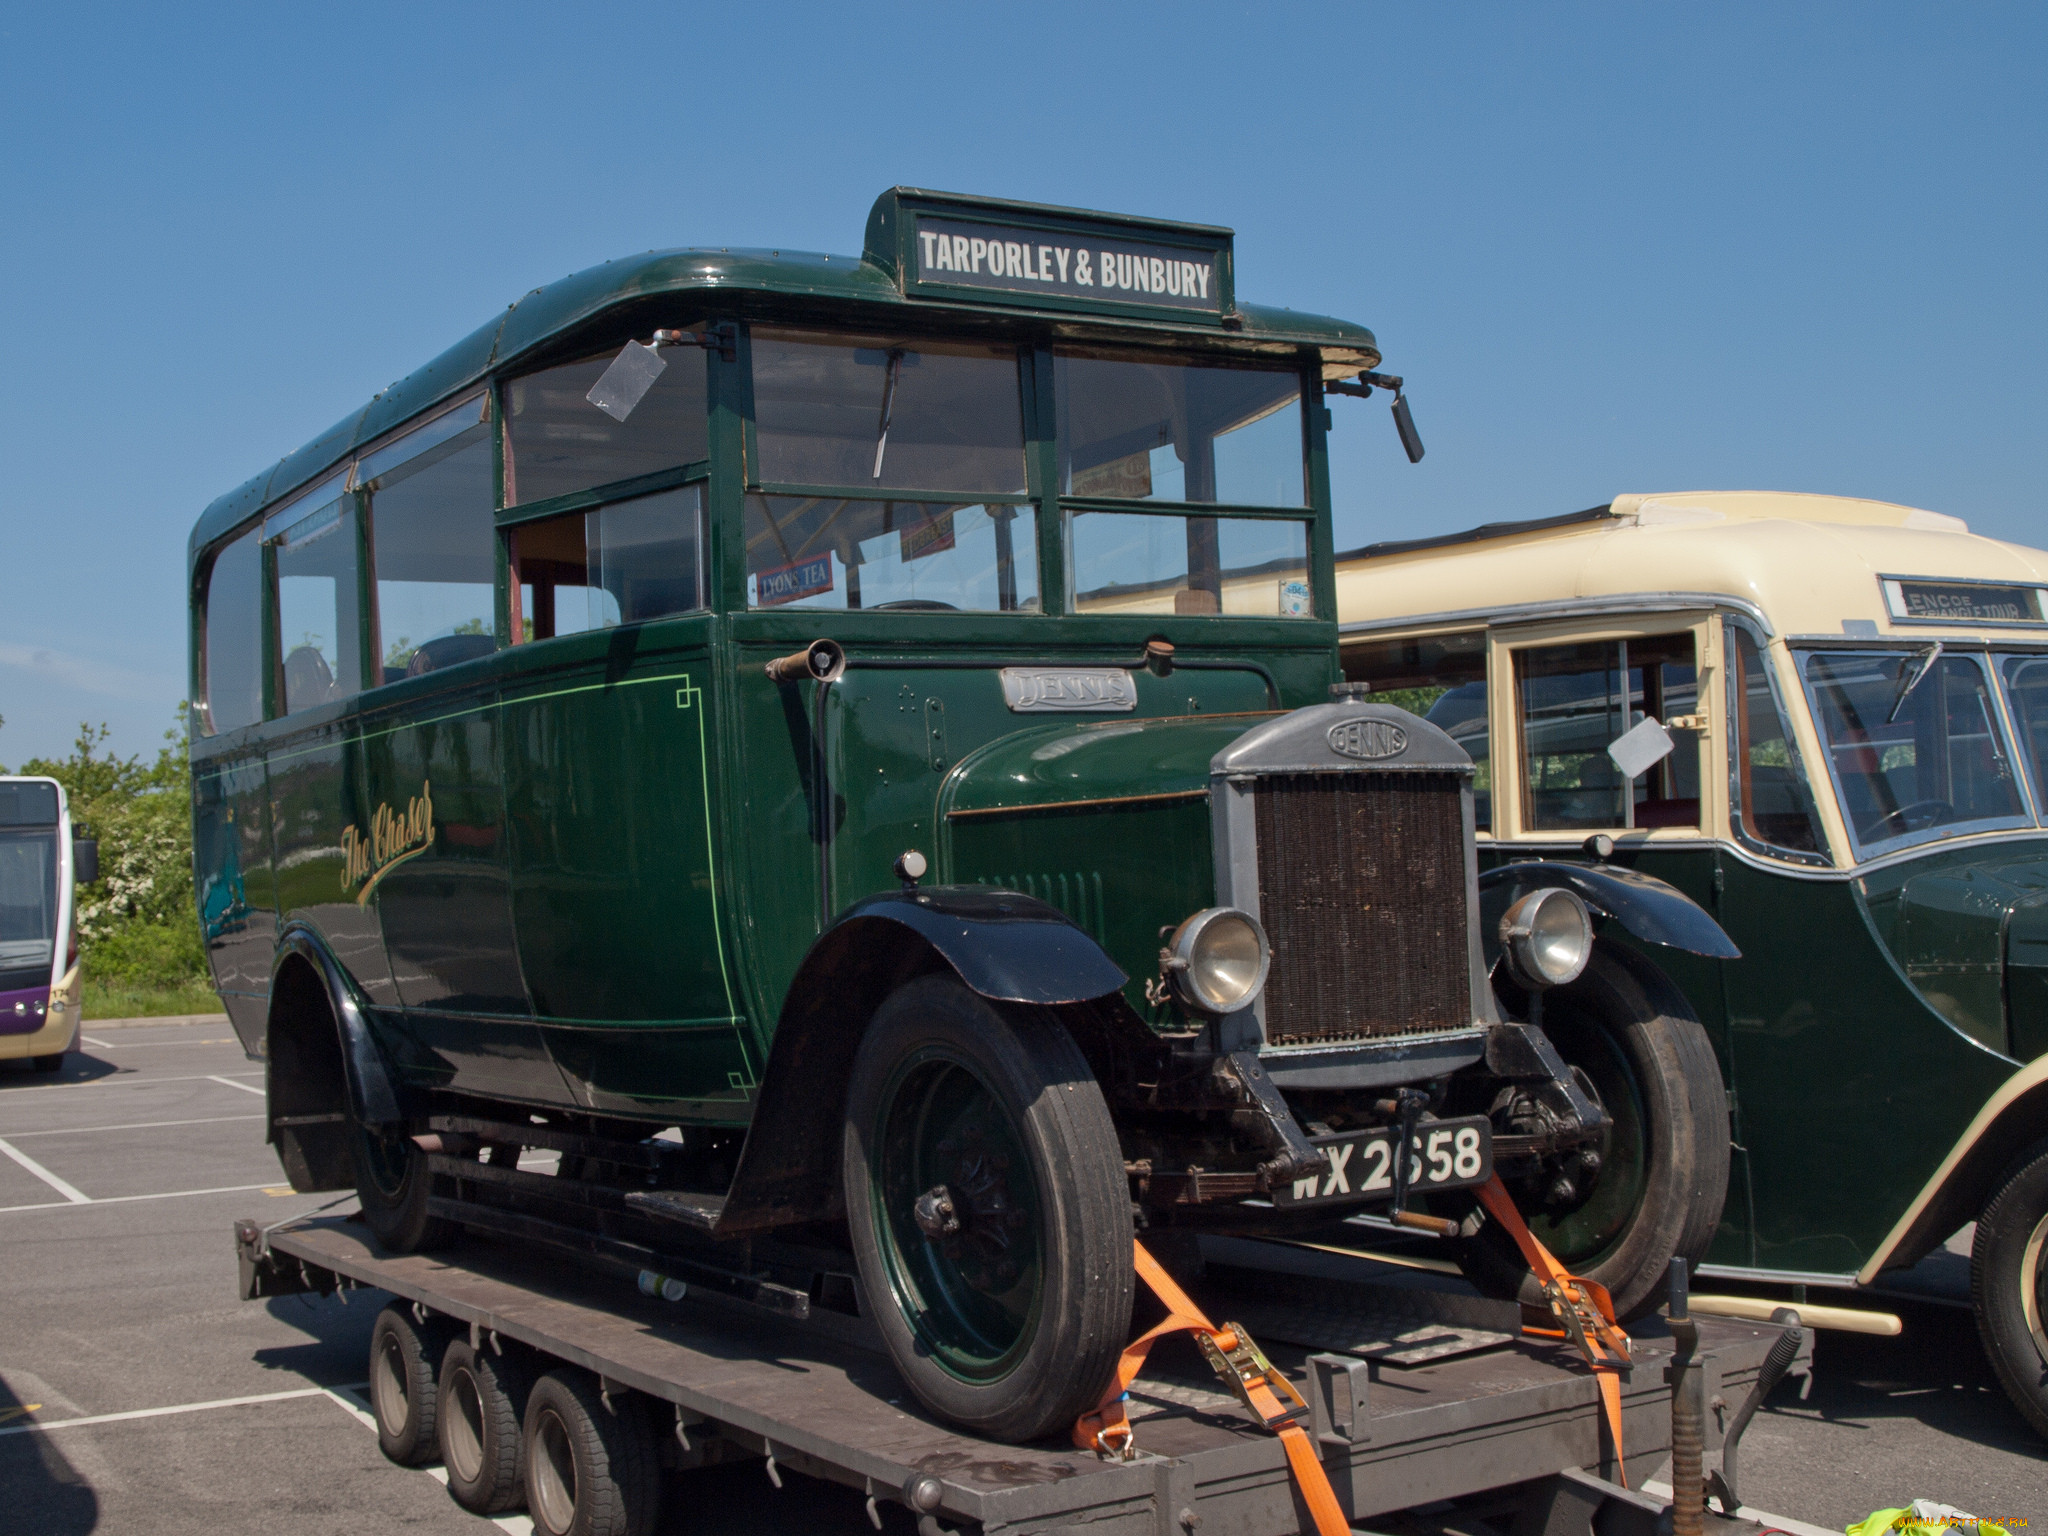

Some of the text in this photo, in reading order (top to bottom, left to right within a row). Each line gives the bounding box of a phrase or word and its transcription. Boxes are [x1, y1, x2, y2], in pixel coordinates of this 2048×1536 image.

[919, 231, 1211, 299] TARPORLEY & BUNBURY
[763, 563, 827, 597] LYONS TEA
[1012, 671, 1128, 707] DENNIS
[1333, 722, 1403, 756] DENNIS
[341, 824, 371, 893] The
[1361, 1127, 1482, 1192] 2658
